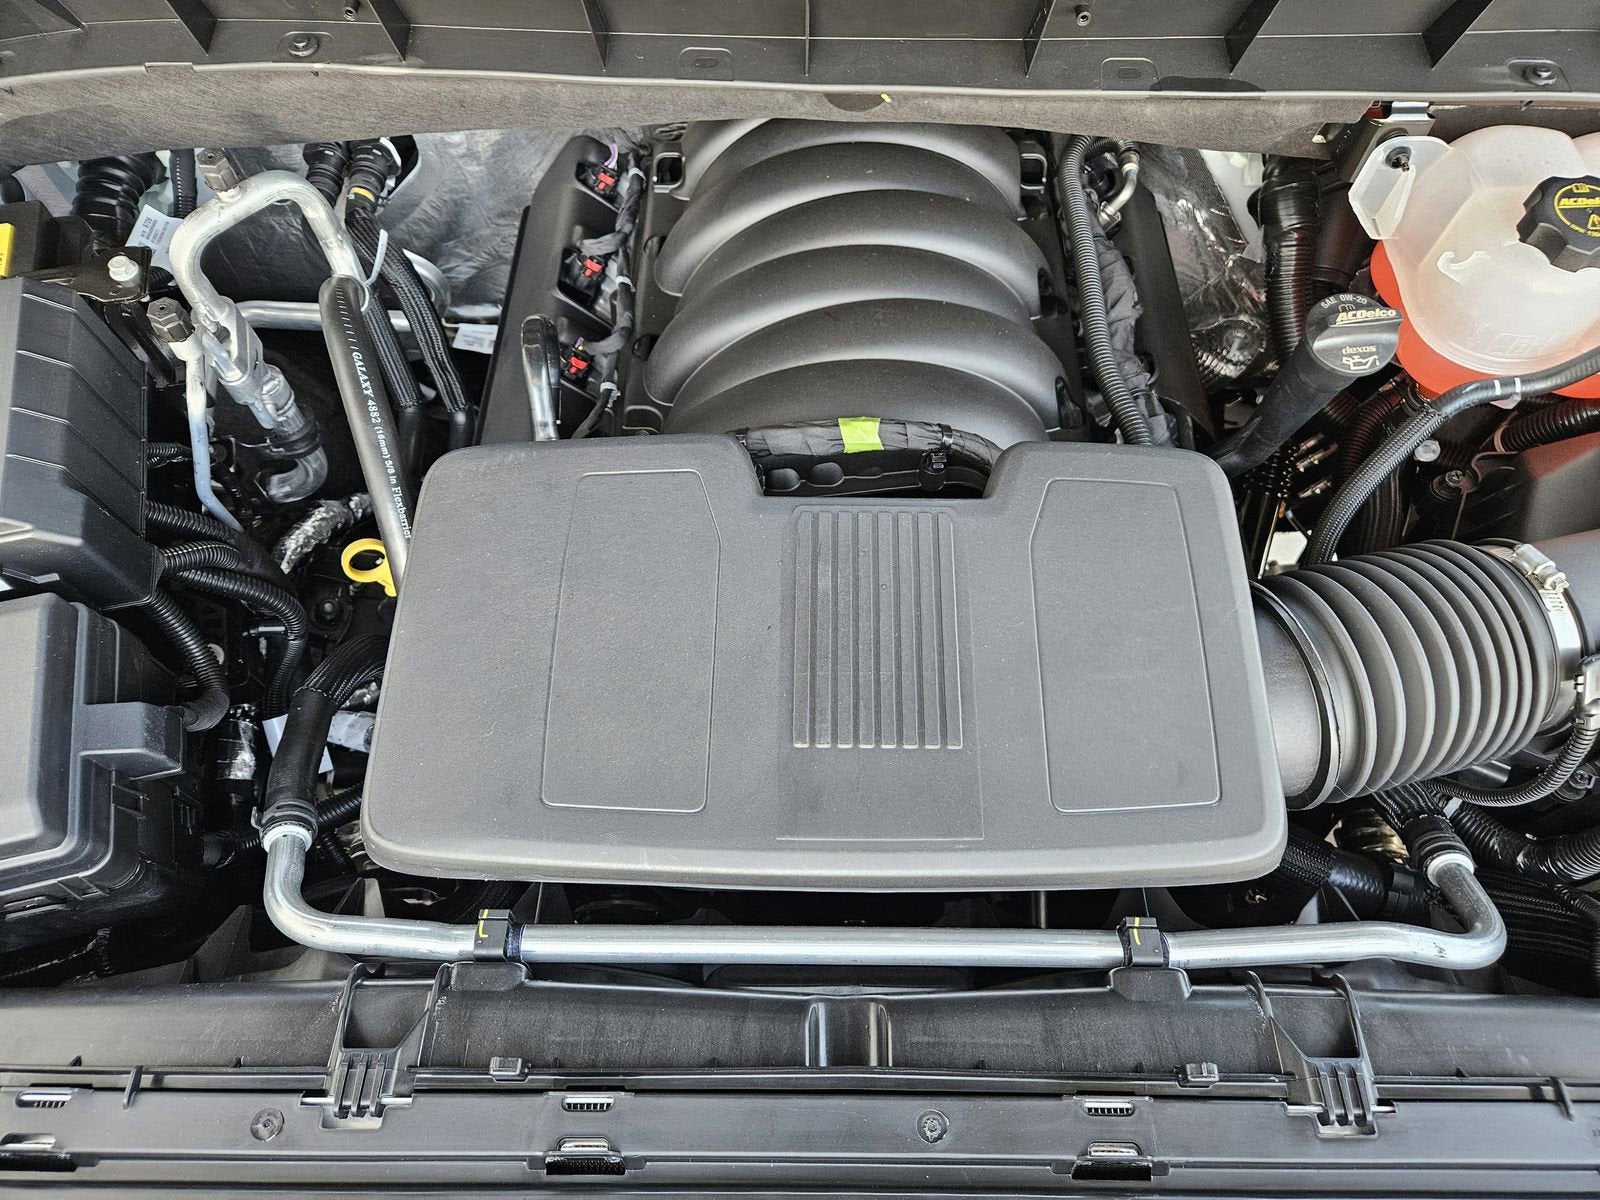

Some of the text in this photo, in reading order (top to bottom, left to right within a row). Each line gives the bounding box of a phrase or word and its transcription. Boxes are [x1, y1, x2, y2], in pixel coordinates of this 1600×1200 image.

[1320, 294, 1367, 309] SAE 0W-20
[1335, 308, 1396, 322] ACDelco
[1342, 345, 1377, 355] dexos
[352, 351, 374, 398] GALAXY
[367, 399, 381, 424] 4882
[374, 426, 391, 459] (16mm)
[384, 459, 396, 474] 5/8
[391, 486, 412, 539] Flexbarrier
